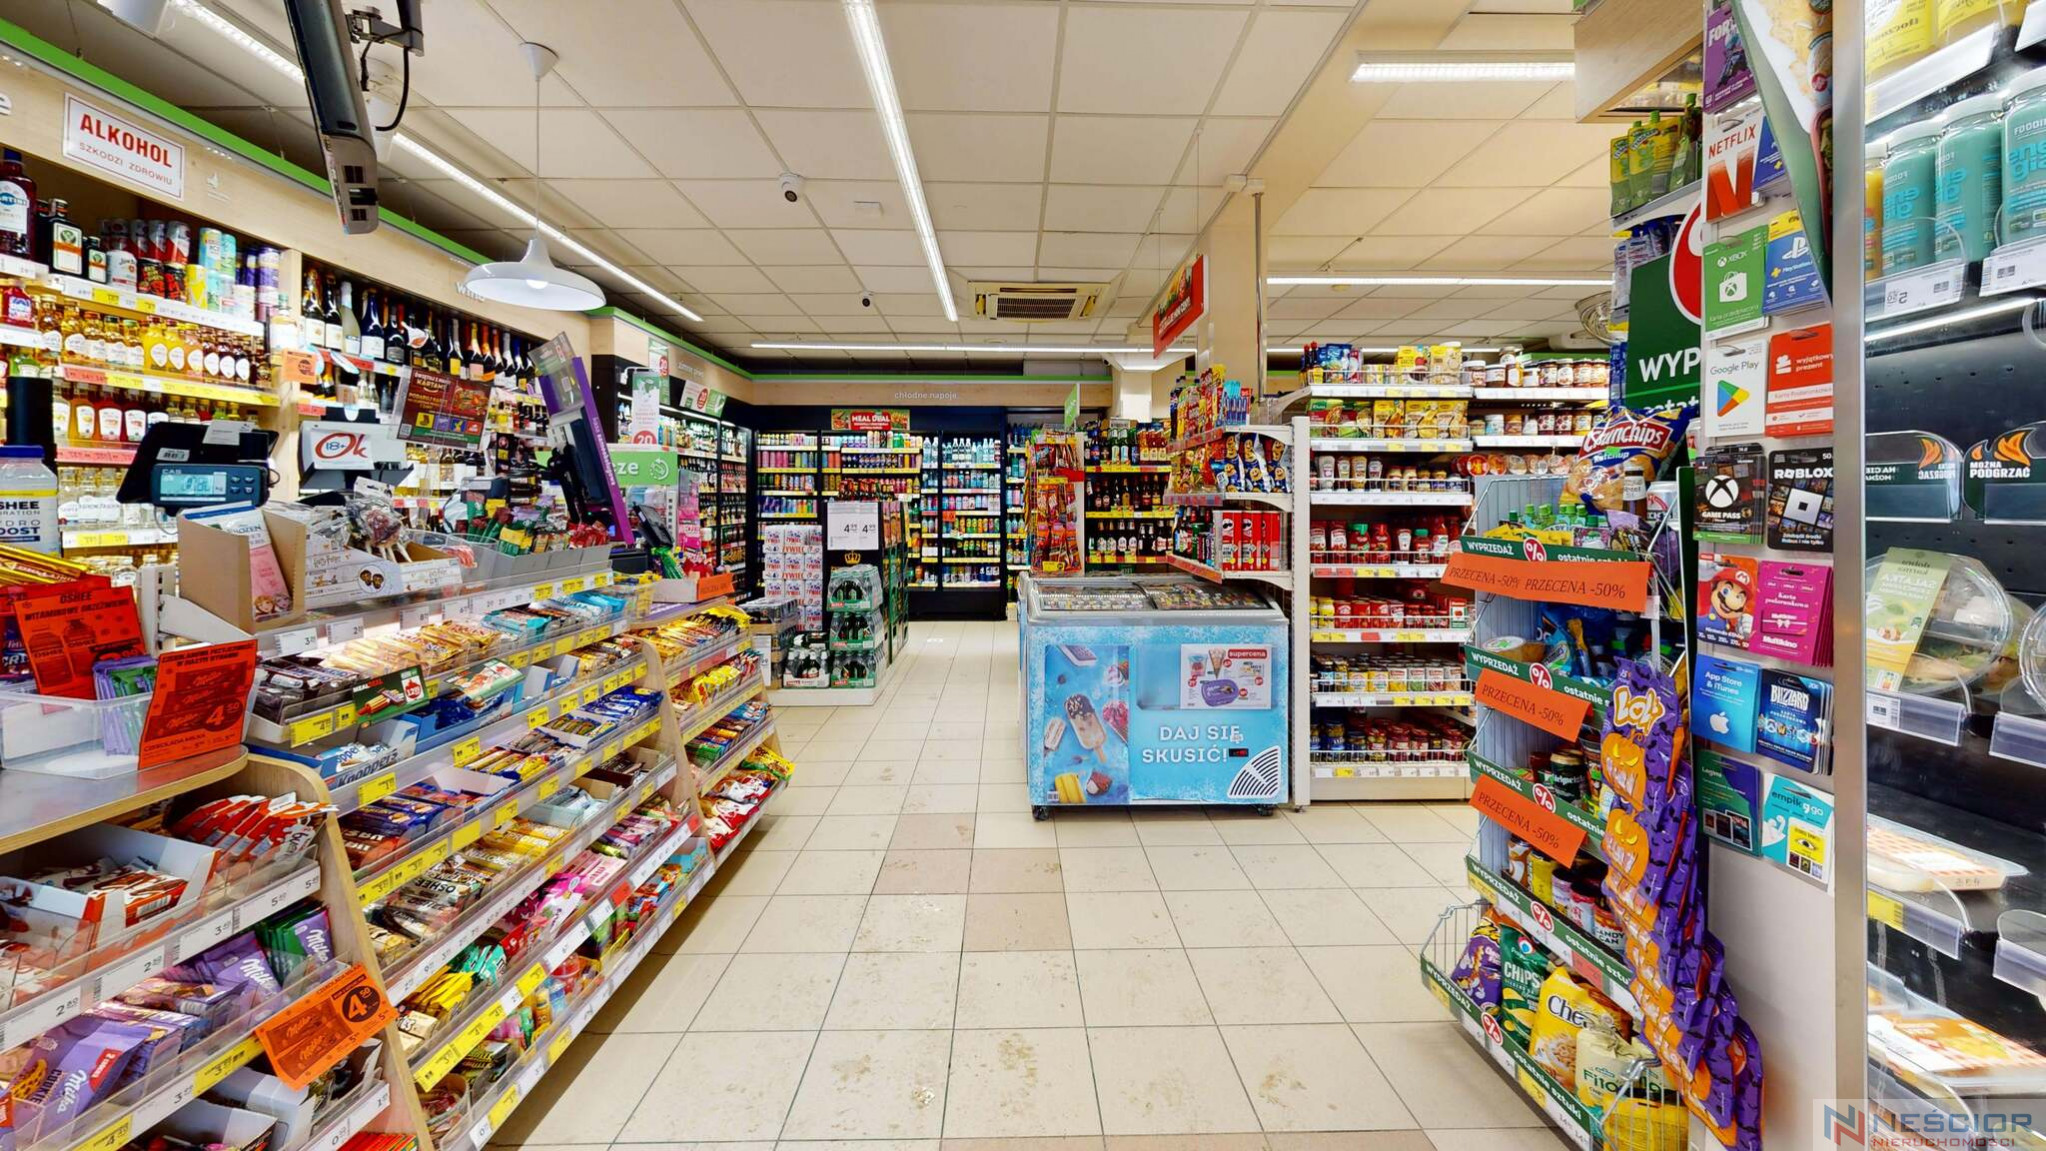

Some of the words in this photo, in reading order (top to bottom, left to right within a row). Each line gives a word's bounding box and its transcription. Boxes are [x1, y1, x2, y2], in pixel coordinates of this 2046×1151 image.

[80, 113, 173, 168] ALKOHOL
[1708, 124, 1757, 159] NETFLIX
[79, 142, 124, 167] SZKODZI
[128, 162, 173, 186] ZDROWIU
[1728, 250, 1748, 262] XBOX
[1640, 346, 1700, 382] WYP
[1710, 363, 1739, 376] Google
[1741, 361, 1759, 373] Play
[894, 391, 927, 400] chłodne
[929, 392, 957, 401] napoje
[1774, 467, 1833, 479] ROBLOX
[1969, 461, 2002, 469] MOŻNA
[1969, 467, 2031, 479] PODGRZAĆ
[1701, 511, 1721, 519] GAME
[1722, 511, 1741, 519] PASS
[1467, 541, 1514, 556] WYPRZEDAŻ
[1450, 567, 1495, 585] PRZECENA
[1525, 578, 1586, 595] PRZECENA
[1590, 582, 1626, 599] -50%
[1763, 635, 1798, 648] Multikino
[1229, 650, 1266, 659] supercena
[1471, 652, 1519, 676] WYPRZEDAŻ
[1564, 685, 1603, 705] ostatnie
[1705, 671, 1720, 684] App
[1721, 675, 1742, 687] Store
[1707, 681, 1713, 689] &
[1714, 682, 1739, 695] iTunes
[1482, 684, 1537, 716] PRZECENA
[1538, 707, 1564, 726] -50%
[1771, 684, 1810, 711] BLIZZARD
[206, 704, 225, 726] 4
[1160, 726, 1199, 741] DAJ
[1142, 743, 1228, 763] SKUSIĆ!
[337, 748, 398, 788] Knoppers
[1474, 758, 1523, 791] WYPRZEDAŻ
[1772, 791, 1802, 807] empik
[1811, 806, 1824, 816] go
[1478, 792, 1531, 833] PRZECENA
[1532, 827, 1560, 850] -50%
[415, 878, 457, 893] OSHEE
[1473, 864, 1521, 904] WYPRZEDAŻ
[1565, 934, 1605, 968] ostatnie
[306, 928, 330, 963] Milka
[240, 958, 277, 993] Milka
[1503, 961, 1541, 988] CHIPS
[348, 994, 368, 1019] 4
[1426, 964, 1472, 1012] WYPRZEDAŻ
[1513, 1050, 1551, 1089] ostatnie
[1551, 1085, 1583, 1120] sztuki
[57, 1069, 87, 1114] Milka
